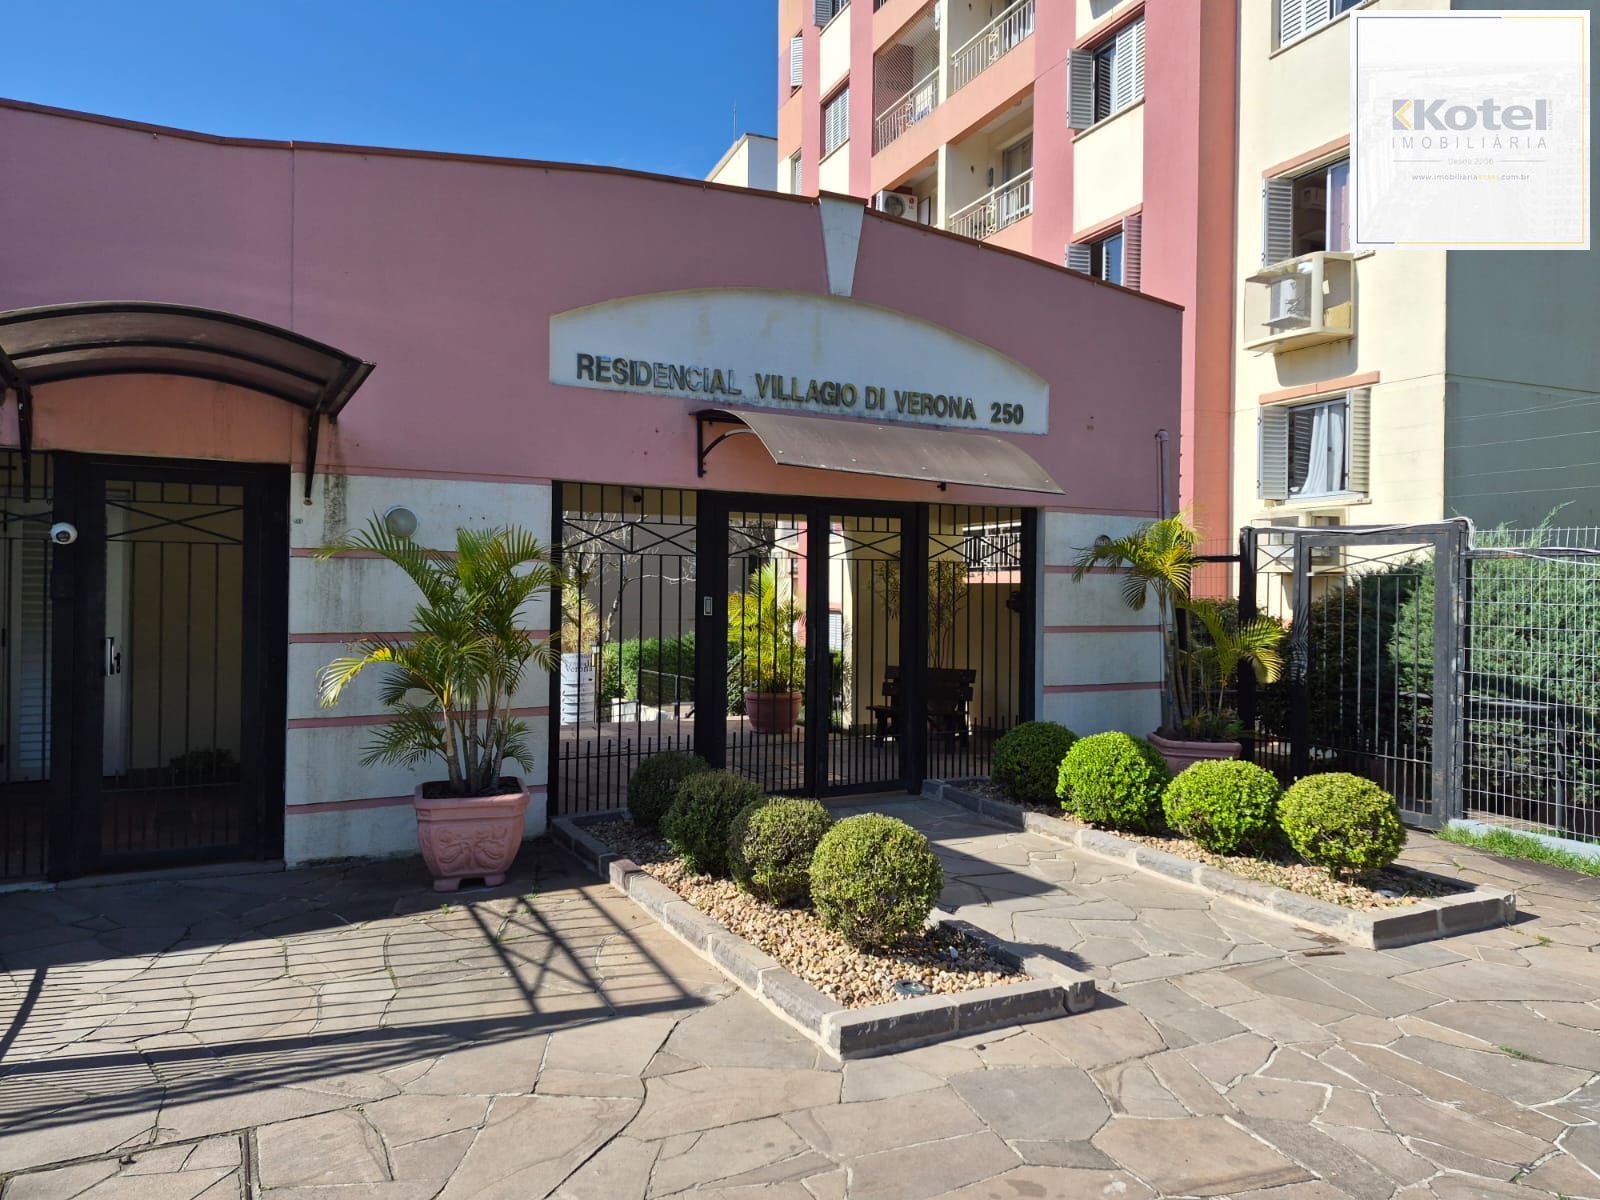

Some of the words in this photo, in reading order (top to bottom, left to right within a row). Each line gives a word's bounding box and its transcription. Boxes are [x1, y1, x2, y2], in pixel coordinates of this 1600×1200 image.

[577, 353, 743, 395] RESIDENCIAL
[755, 373, 857, 407] VILLAGIO
[865, 386, 885, 410] DI
[893, 390, 977, 420] VERONA
[990, 402, 1024, 425] 250
